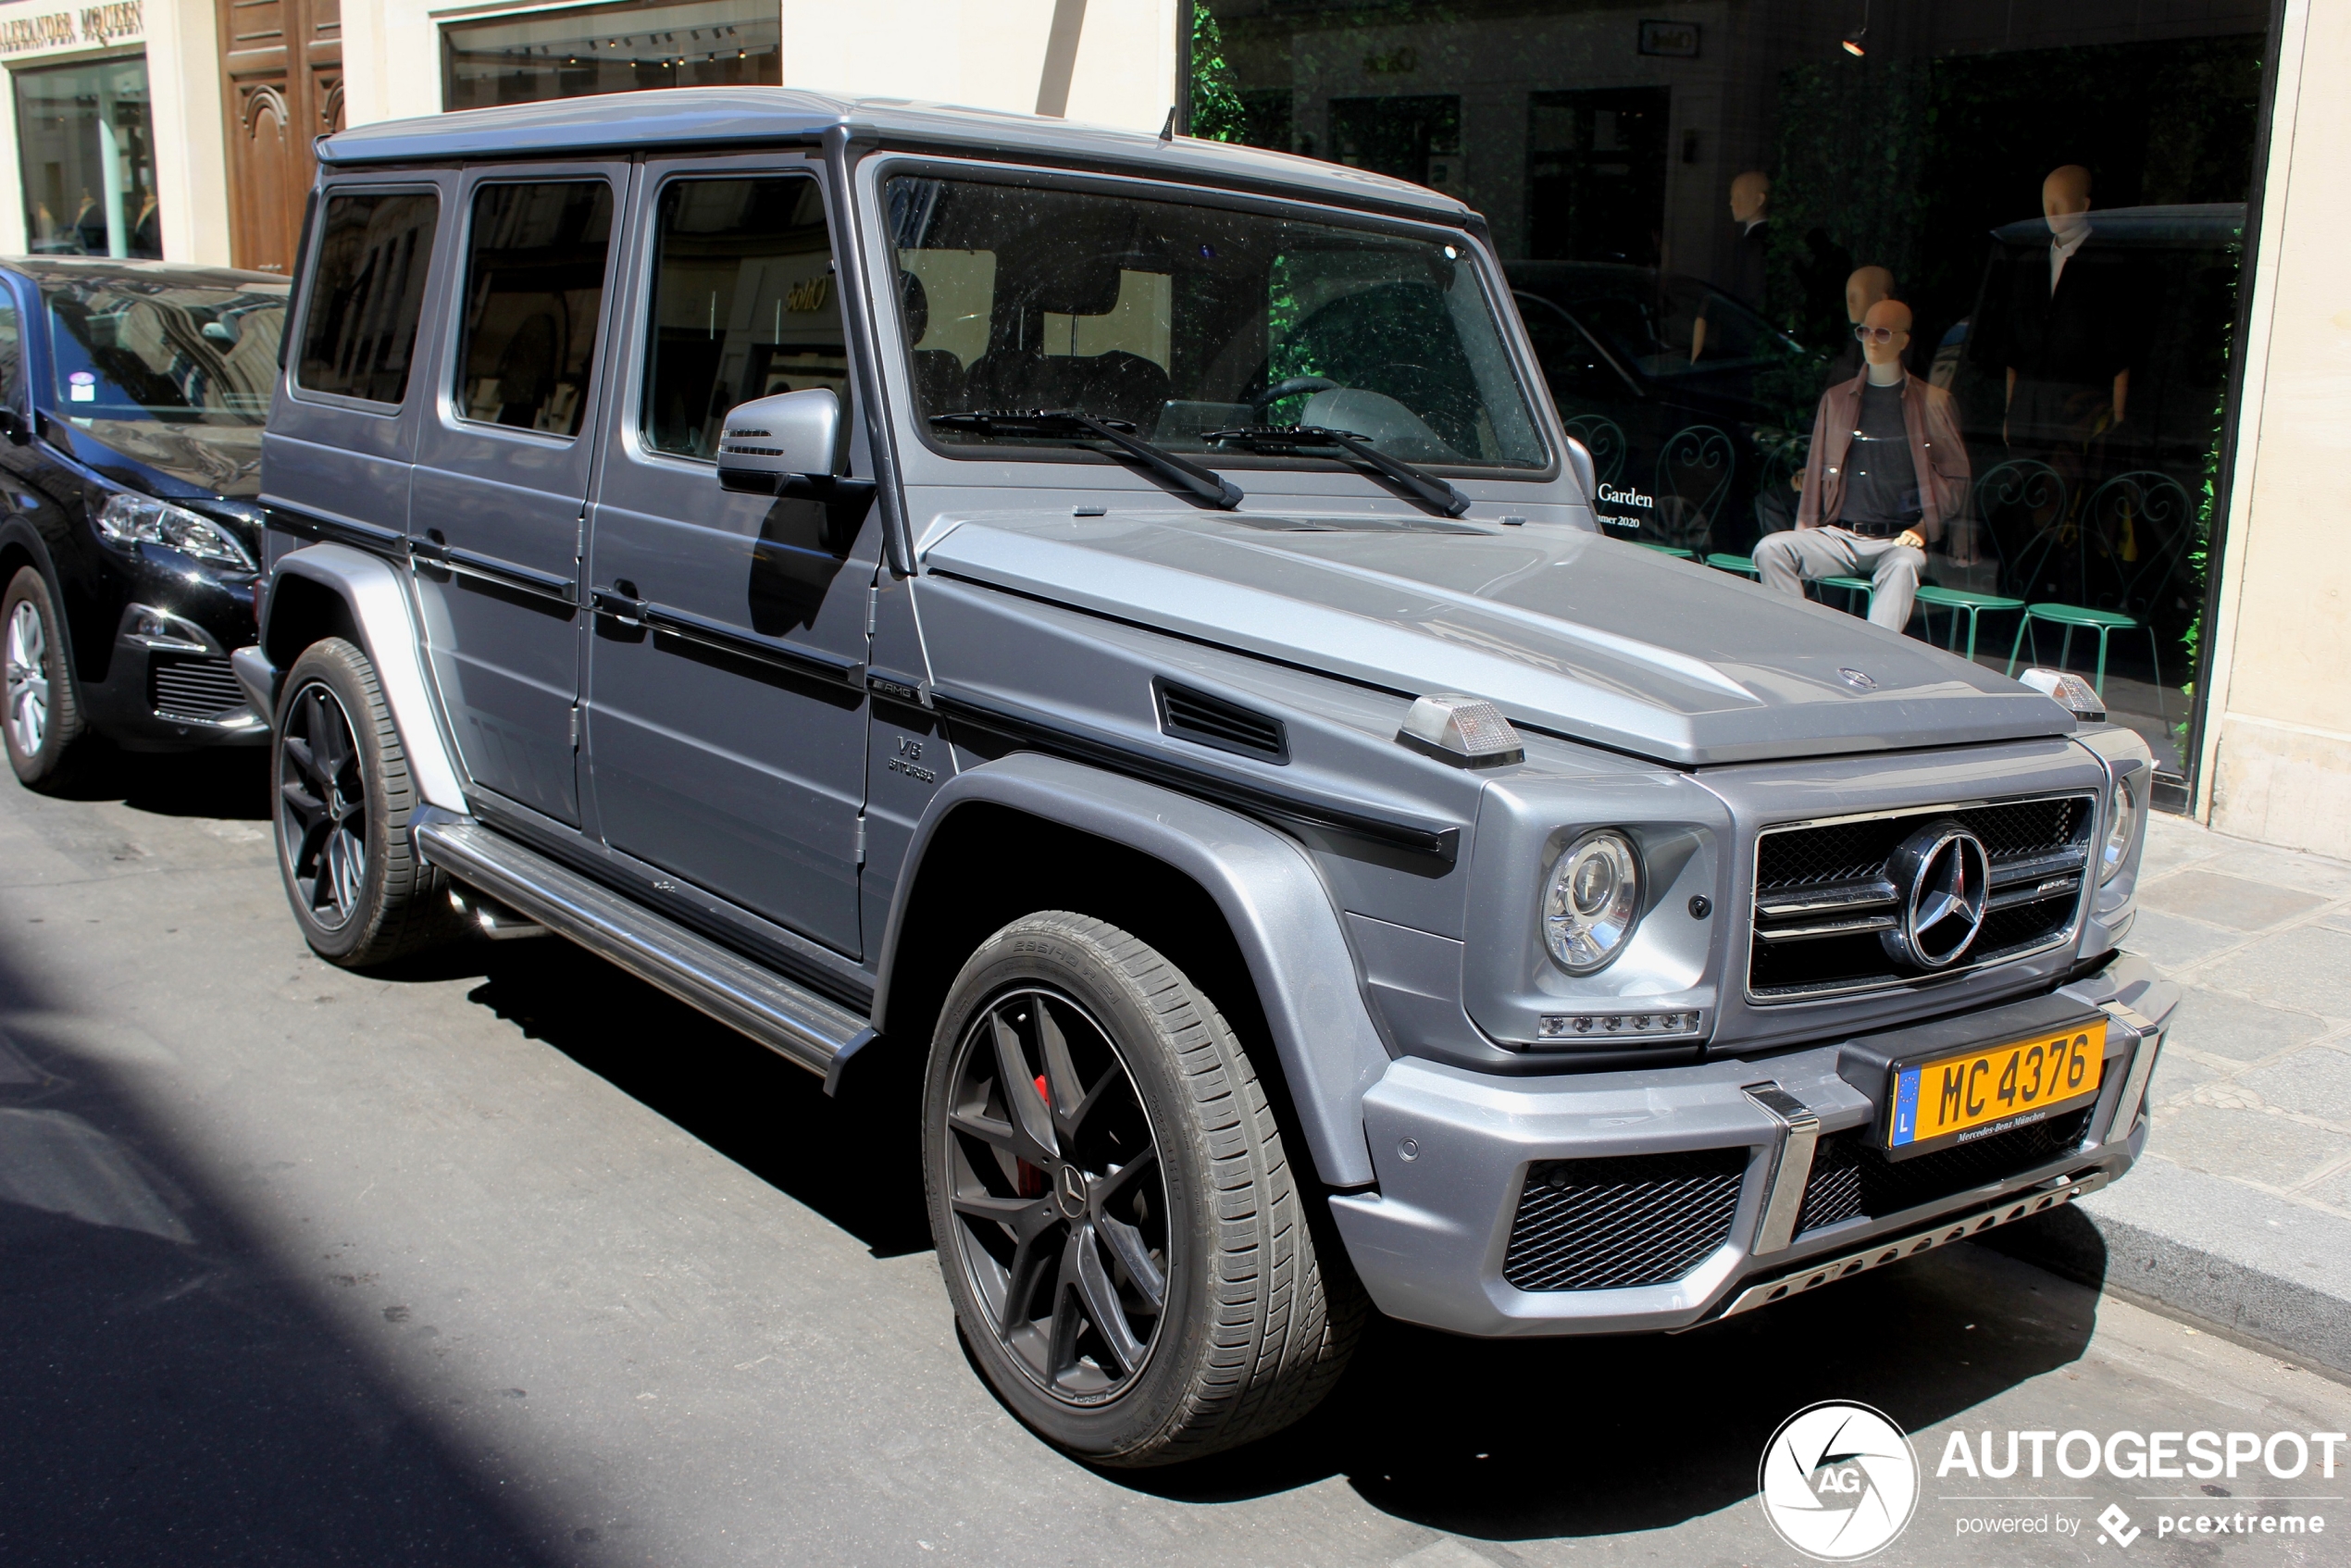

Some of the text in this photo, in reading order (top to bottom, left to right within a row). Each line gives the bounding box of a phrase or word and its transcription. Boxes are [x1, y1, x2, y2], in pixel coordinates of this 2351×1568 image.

[1598, 483, 1653, 508] Garden
[1617, 516, 1640, 529] 2020
[885, 684, 912, 697] AMG
[897, 736, 923, 760] V8
[888, 757, 937, 783] BITURBO
[1938, 1034, 2088, 1126] MC 4376
[1899, 1113, 1909, 1133] L
[1957, 1111, 2046, 1143] Mercedes-Benz München
